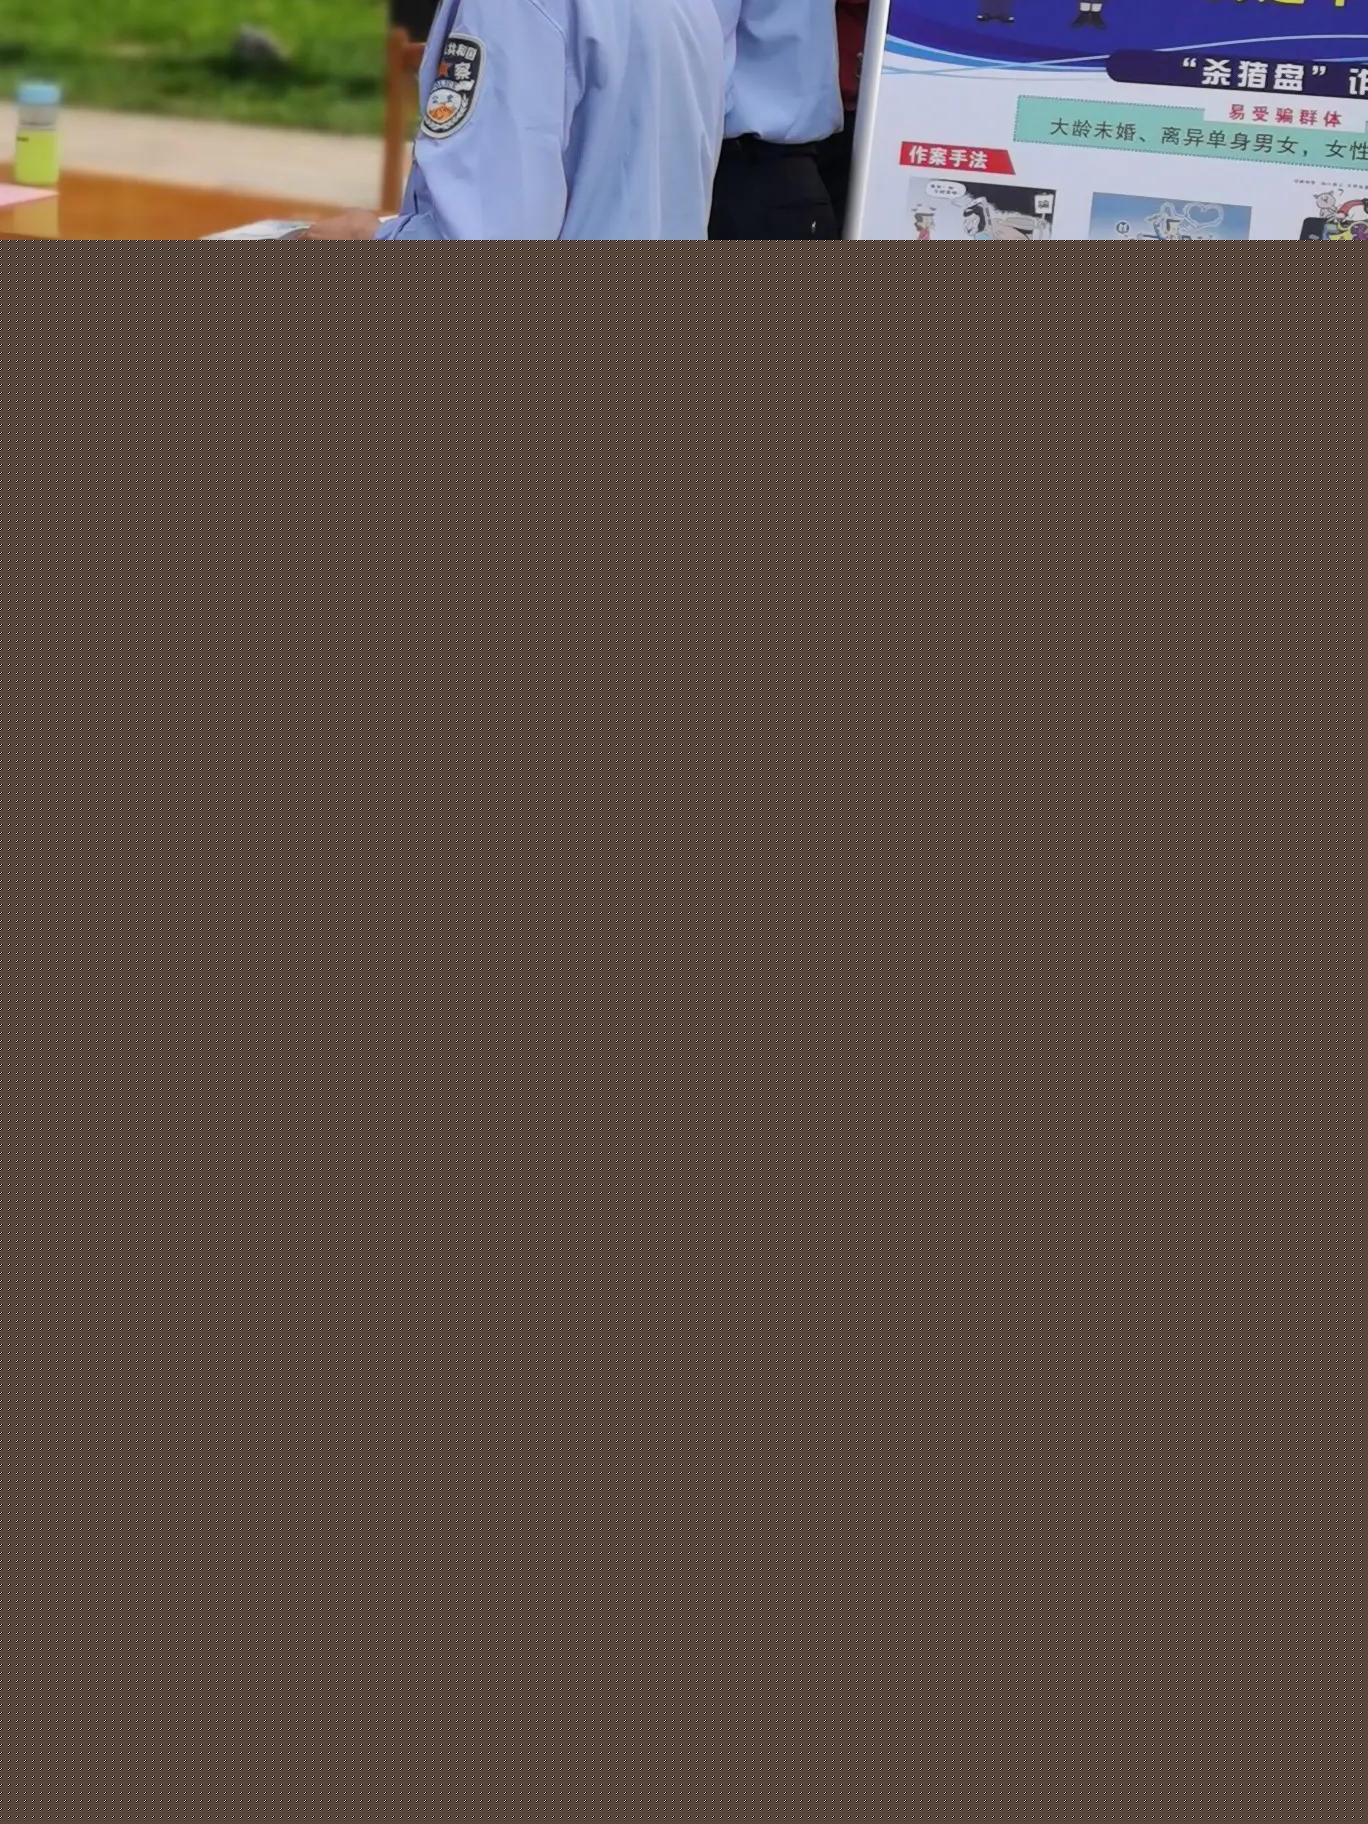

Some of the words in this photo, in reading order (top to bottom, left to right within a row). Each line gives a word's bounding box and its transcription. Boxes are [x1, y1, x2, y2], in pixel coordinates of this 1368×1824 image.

[1228, 103, 1343, 127] 易受骗群体
[909, 145, 988, 169] 作案手法
